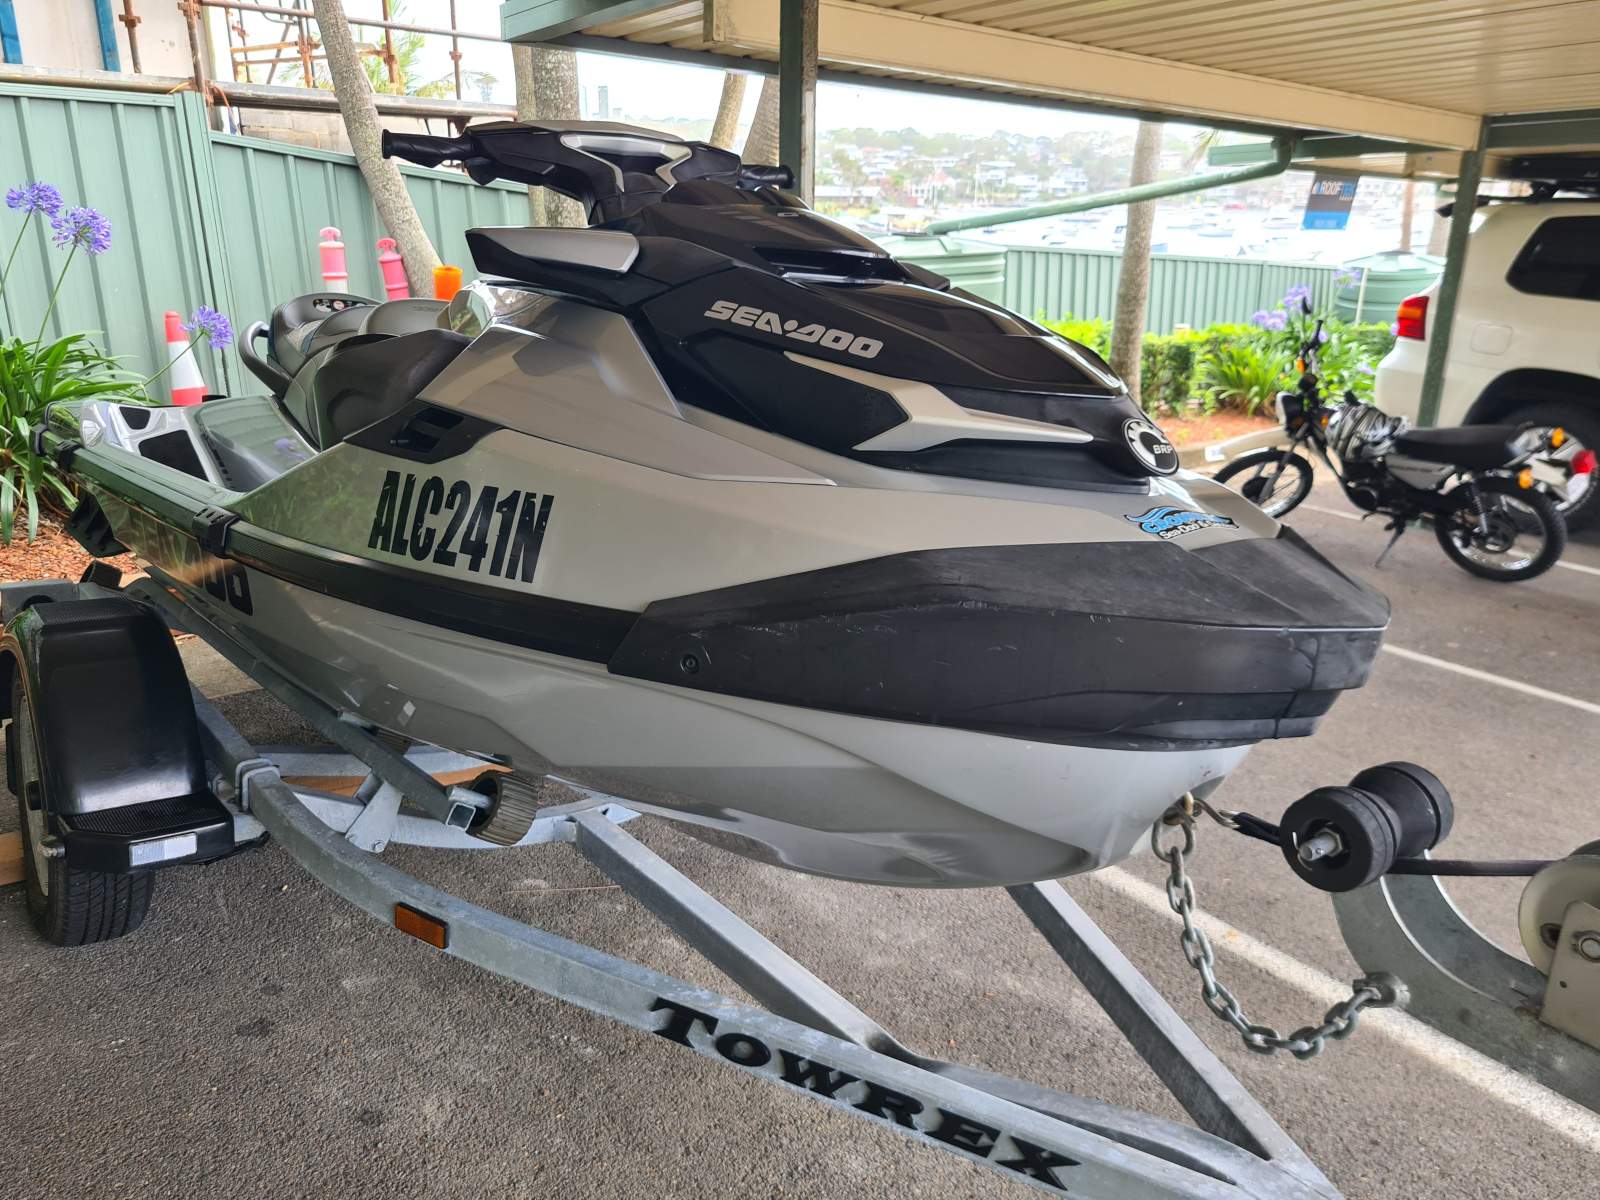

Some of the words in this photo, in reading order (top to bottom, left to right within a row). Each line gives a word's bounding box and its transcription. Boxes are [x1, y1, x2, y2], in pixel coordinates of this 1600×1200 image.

[1153, 444, 1173, 454] BRP
[368, 470, 555, 584] ALC241N
[649, 996, 1082, 1192] TOWREX
